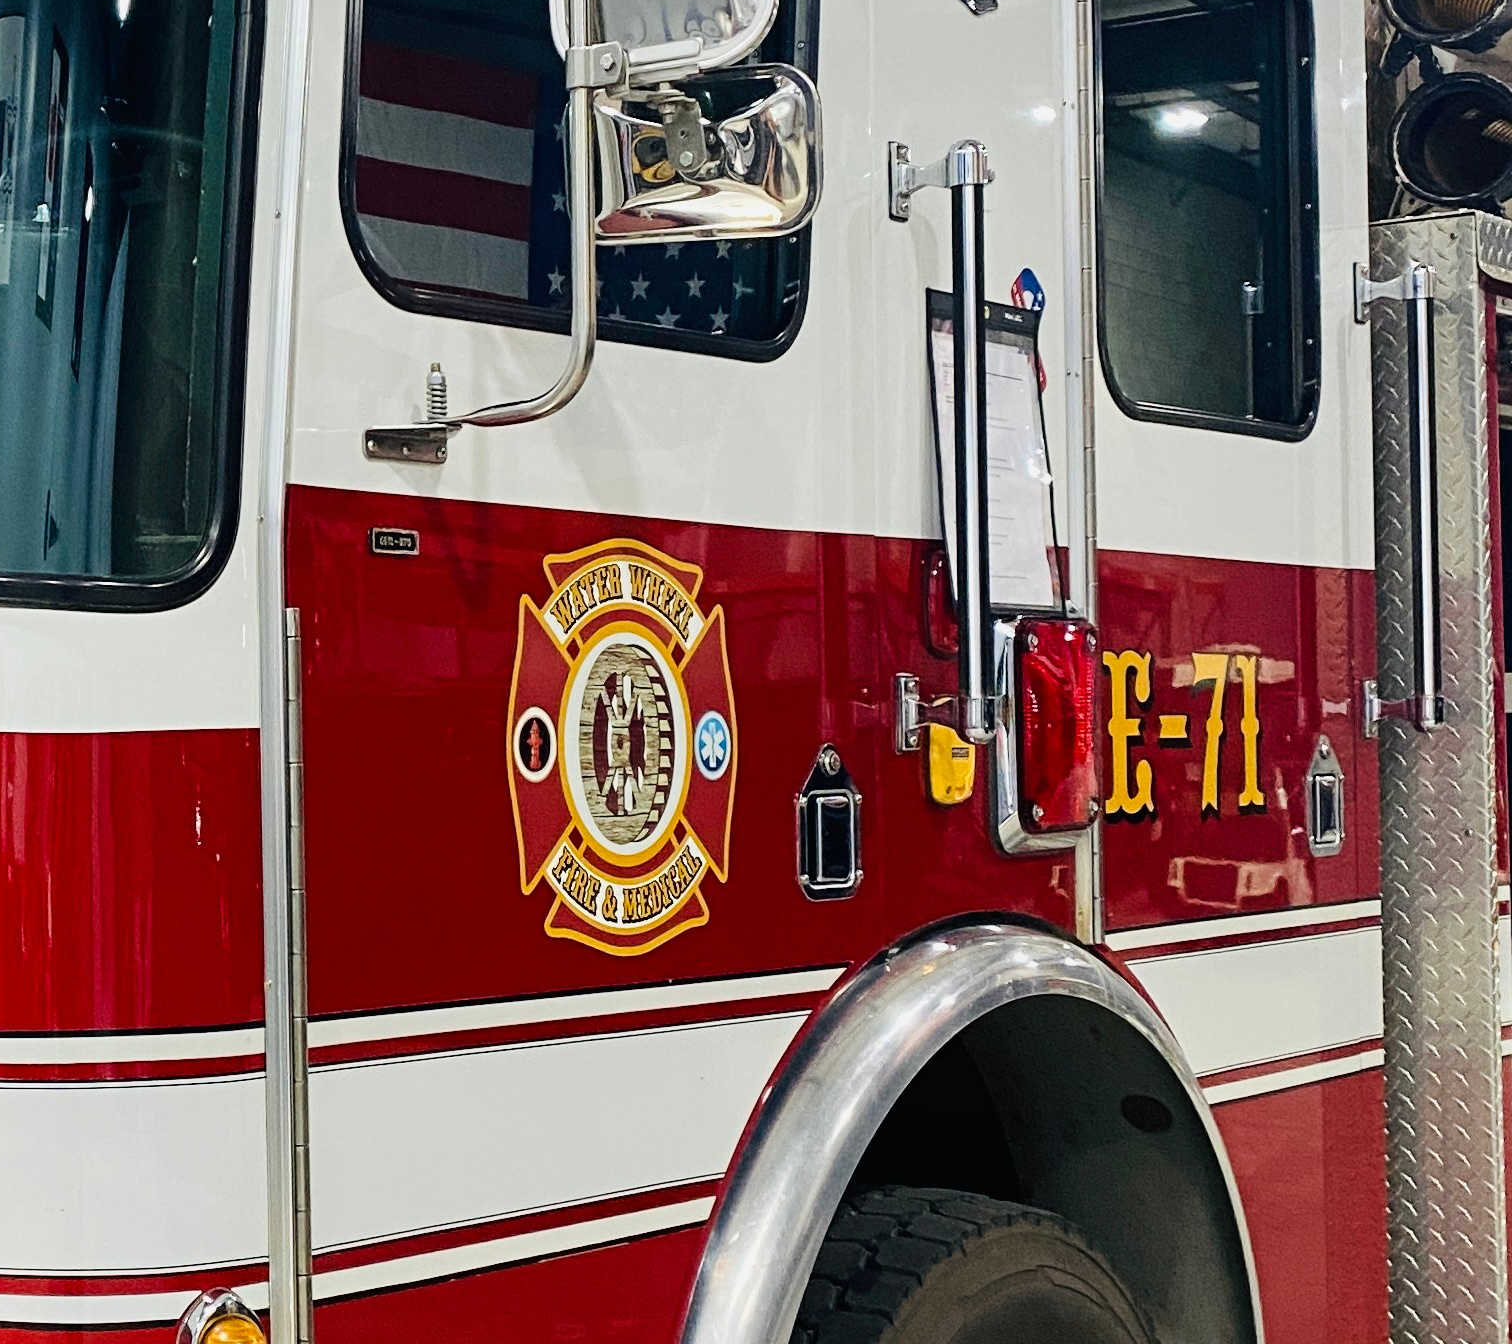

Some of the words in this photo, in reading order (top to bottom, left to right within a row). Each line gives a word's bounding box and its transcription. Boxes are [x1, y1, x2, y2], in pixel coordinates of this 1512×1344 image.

[550, 564, 623, 634] WATER
[628, 564, 693, 642] WHEEL
[1103, 650, 1269, 822] E-71
[552, 846, 601, 916] FIRE
[602, 885, 618, 923] &
[622, 845, 702, 924] MEDICAL
